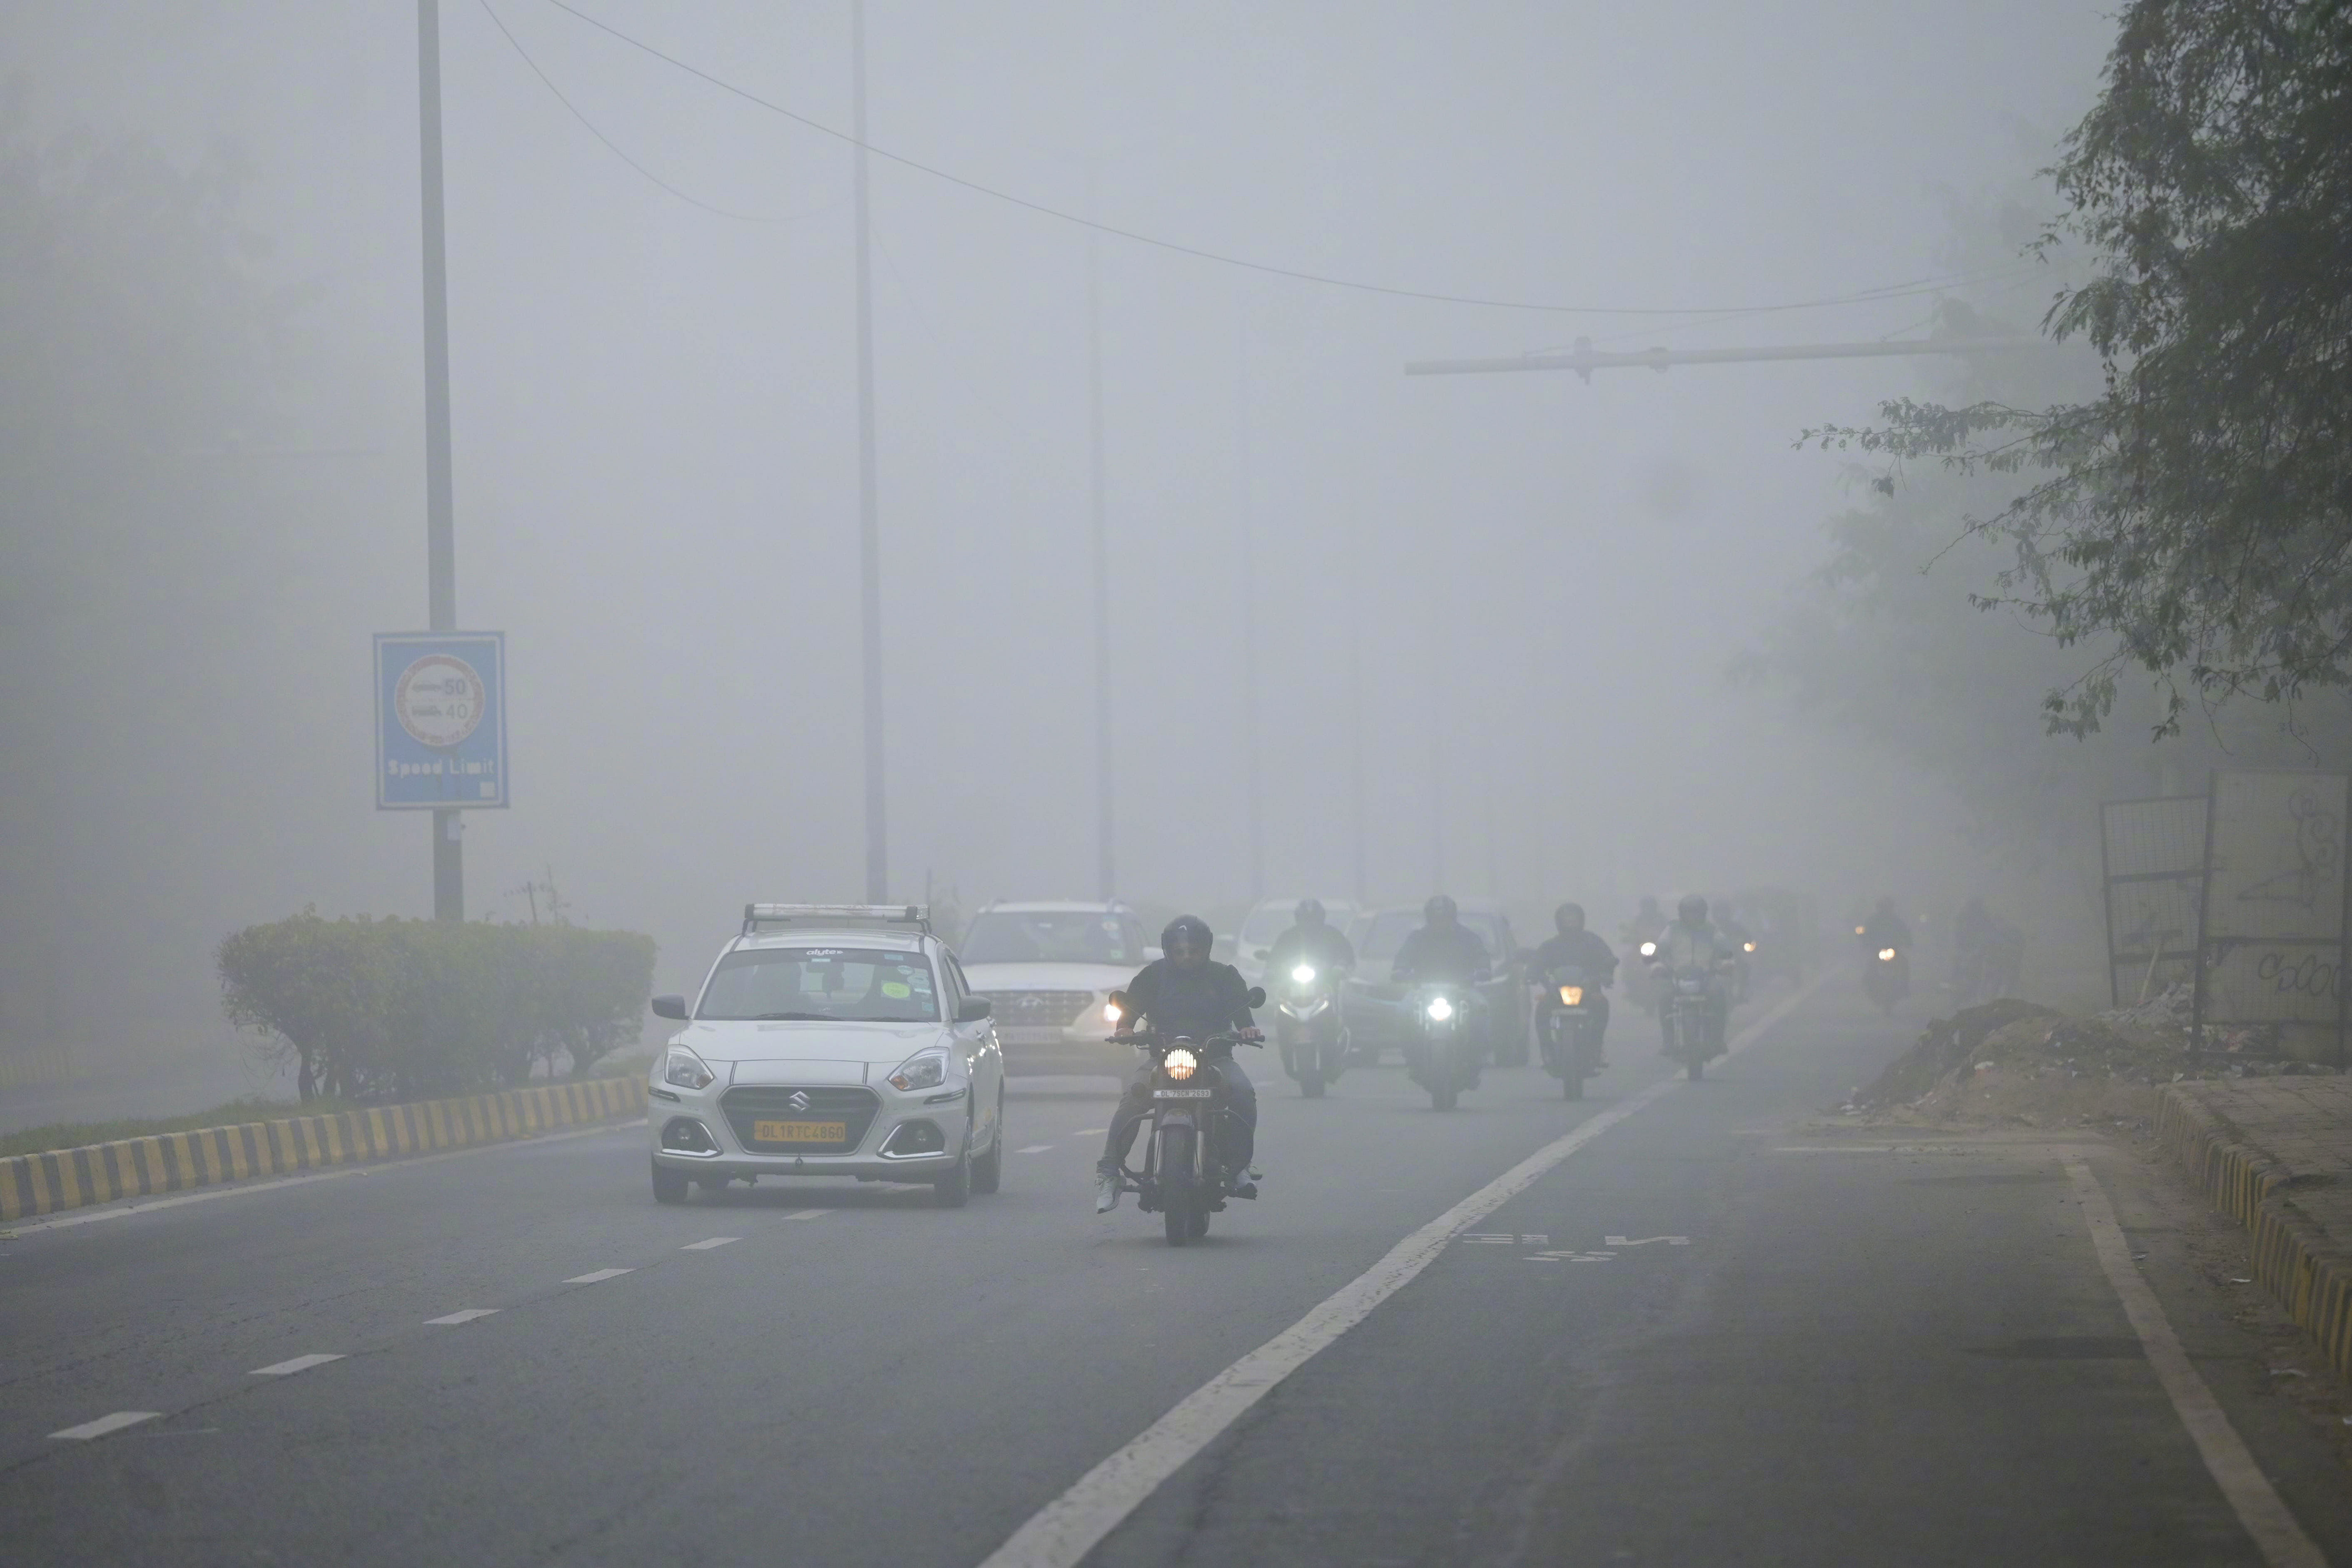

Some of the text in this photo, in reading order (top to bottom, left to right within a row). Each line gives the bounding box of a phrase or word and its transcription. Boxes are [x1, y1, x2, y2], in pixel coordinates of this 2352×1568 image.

[444, 678, 466, 695] 50
[446, 704, 468, 719] 40
[388, 758, 494, 779] Speed Limit
